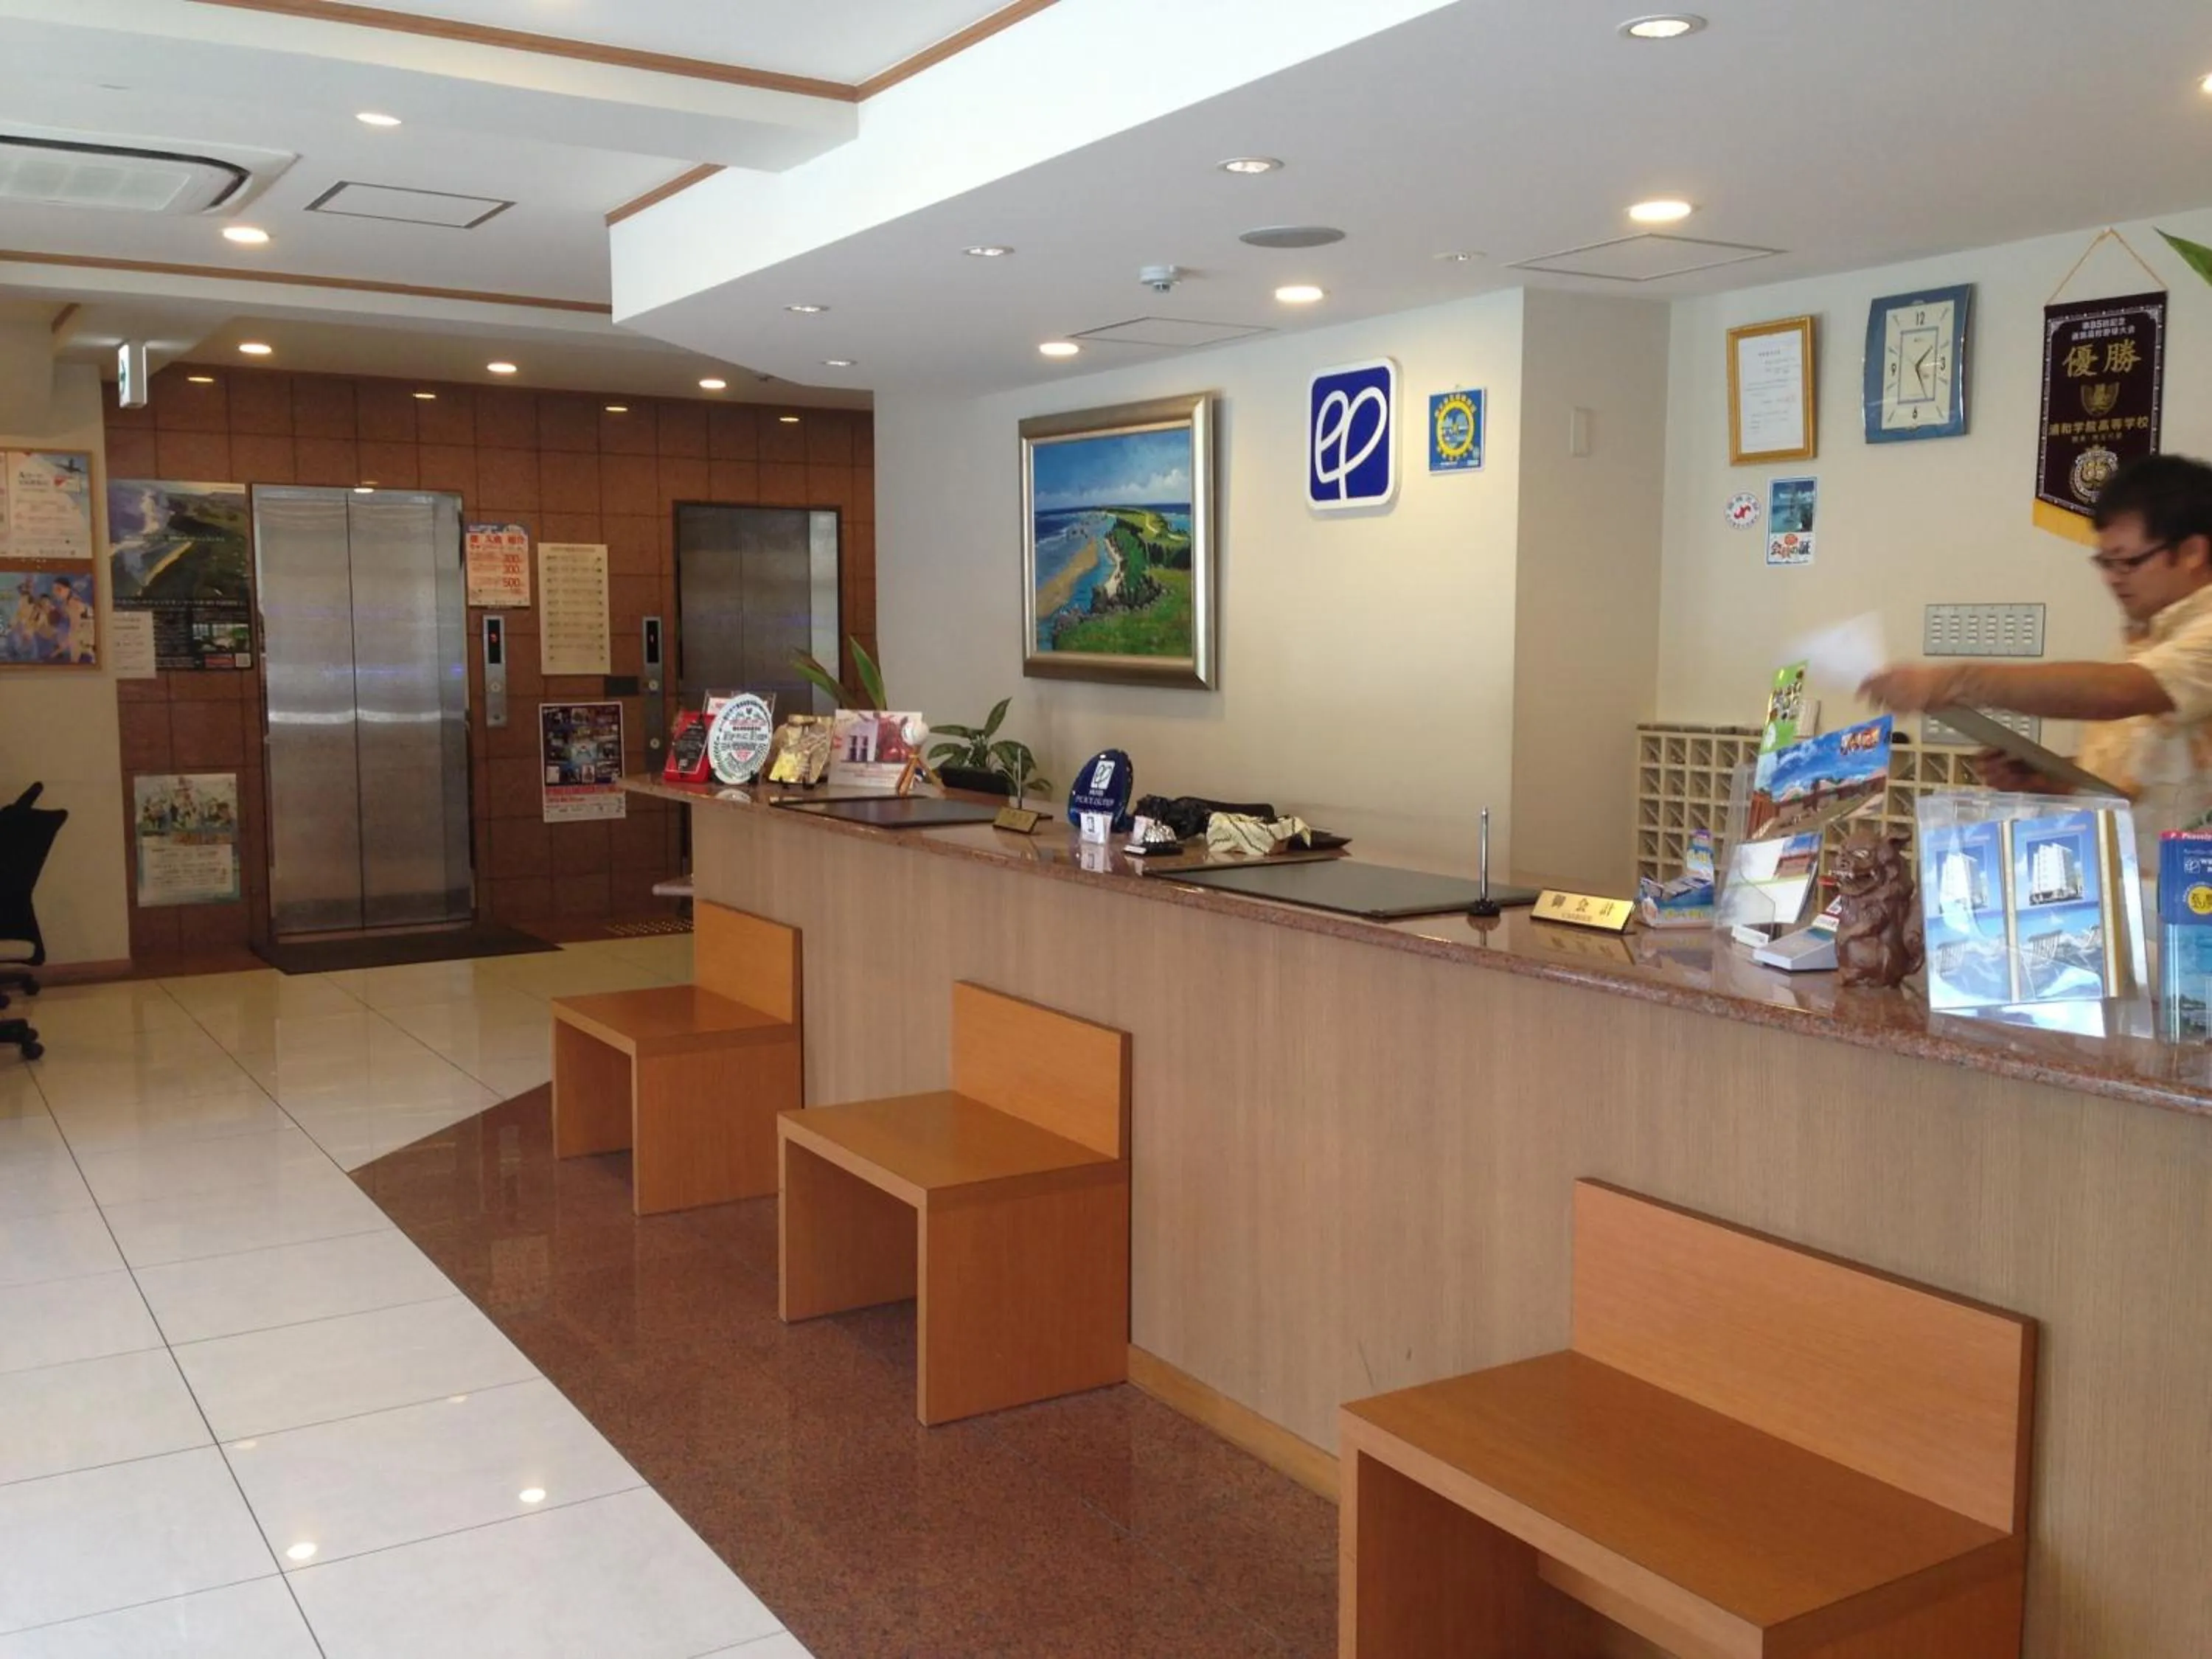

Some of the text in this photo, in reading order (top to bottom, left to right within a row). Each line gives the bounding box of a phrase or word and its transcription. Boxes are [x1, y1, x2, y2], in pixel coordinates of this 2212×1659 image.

[1916, 310, 1925, 325] 12
[1941, 356, 1946, 371] 3
[2062, 338, 2142, 378] 優勝
[1891, 362, 1897, 377] 9
[1912, 407, 1918, 420] 6
